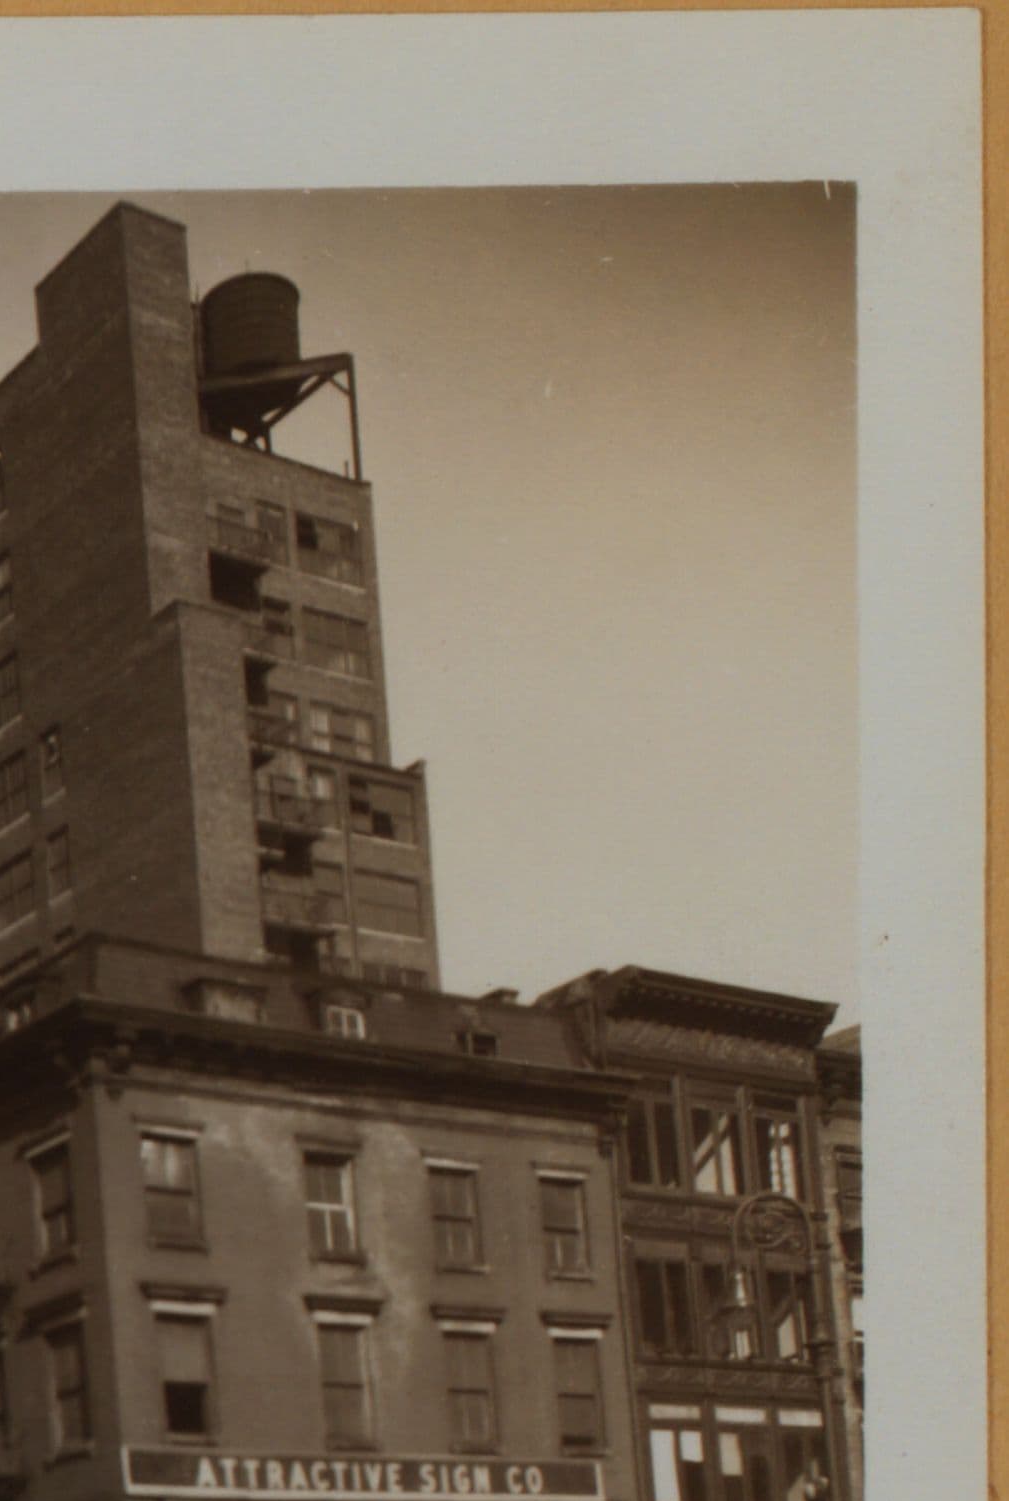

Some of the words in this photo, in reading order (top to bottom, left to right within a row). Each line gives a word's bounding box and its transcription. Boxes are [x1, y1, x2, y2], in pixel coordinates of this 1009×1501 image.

[195, 1456, 403, 1493] ATTRACTIVE
[418, 1463, 492, 1494] SIGN
[505, 1465, 544, 1495] CO
